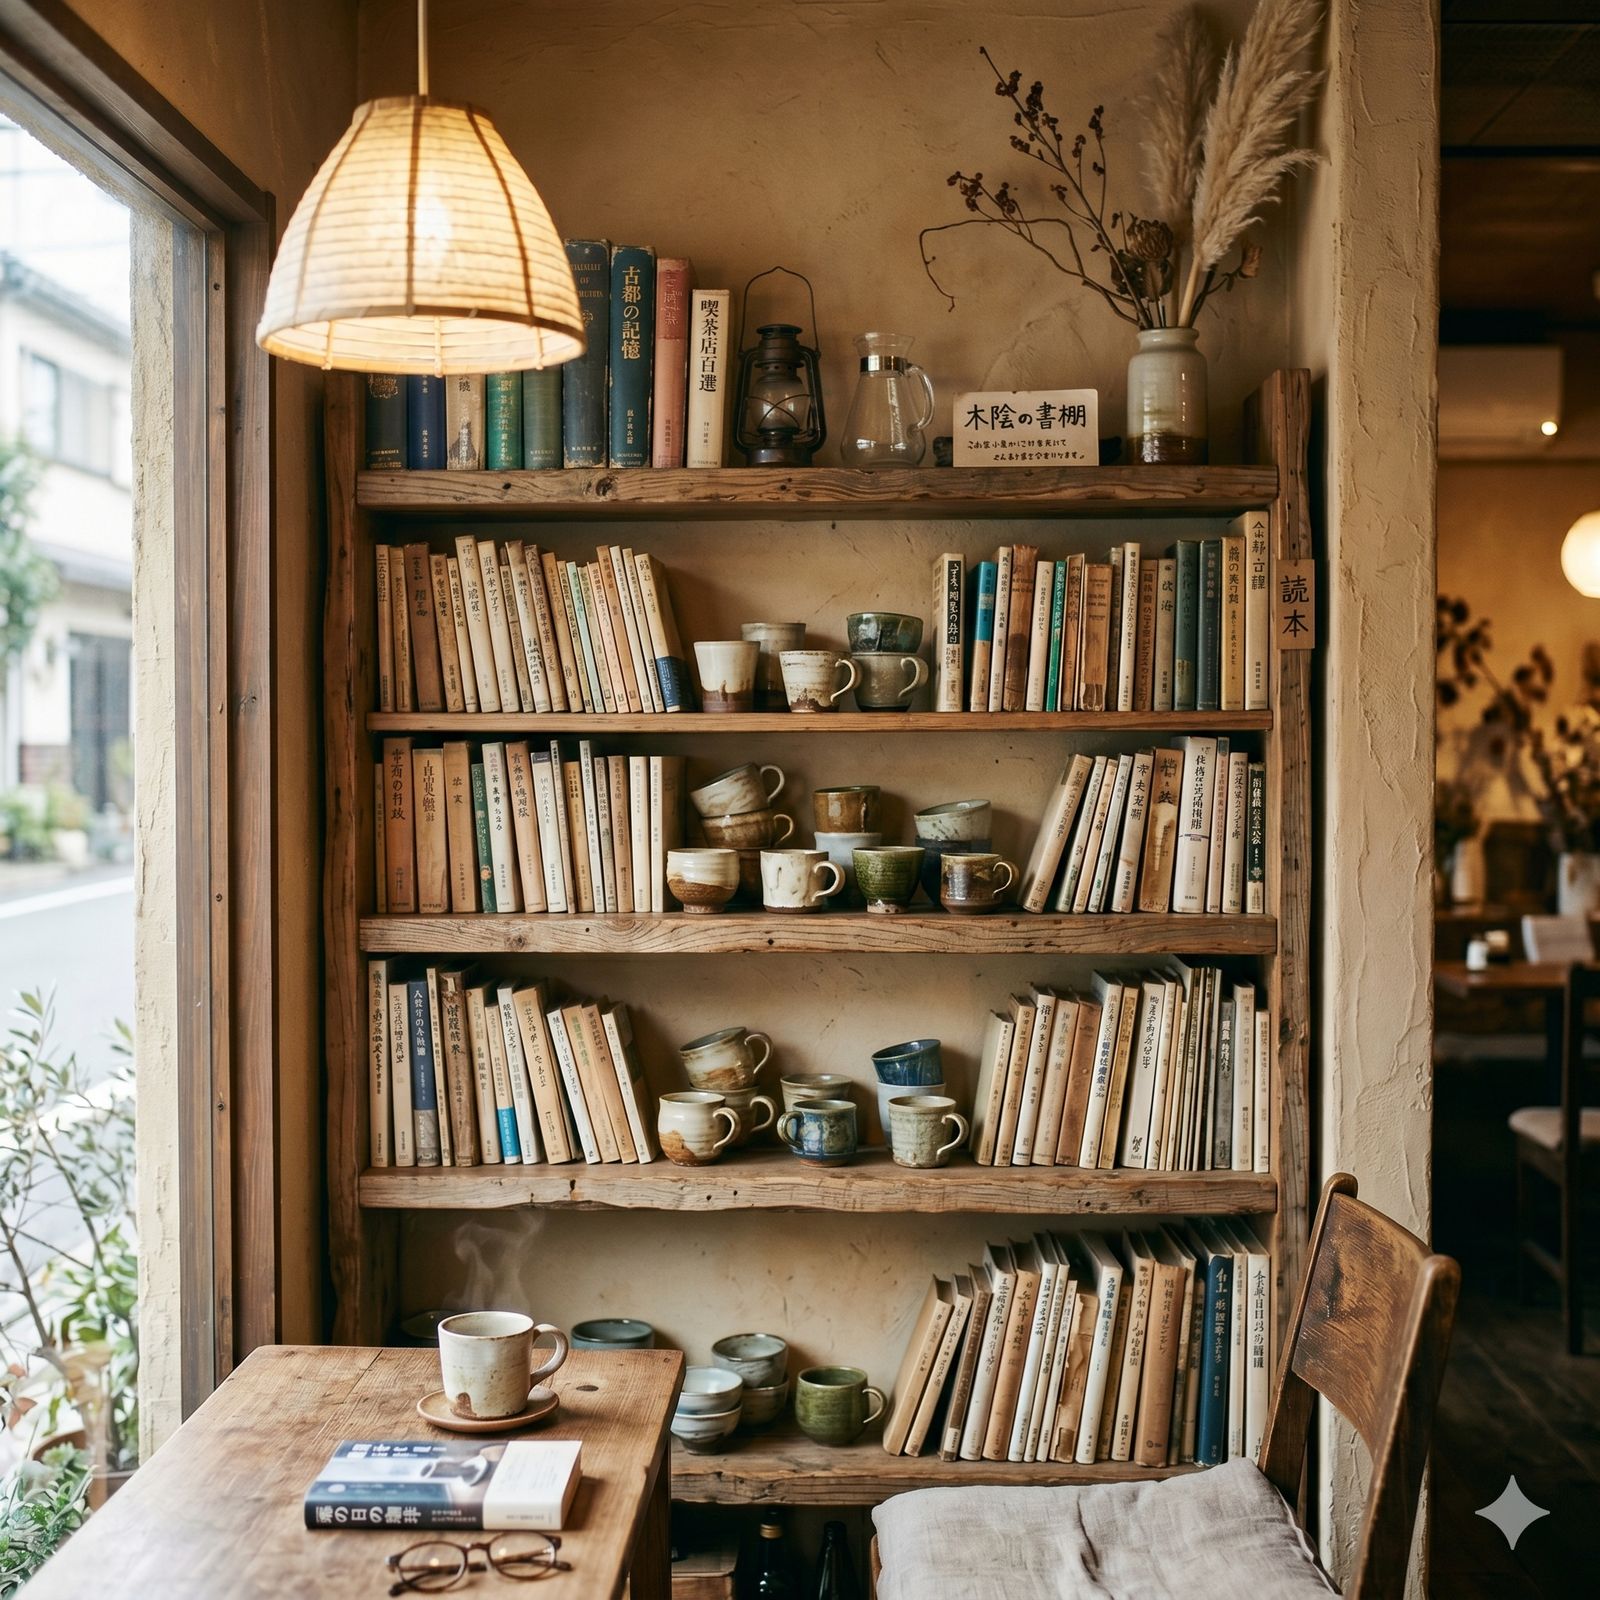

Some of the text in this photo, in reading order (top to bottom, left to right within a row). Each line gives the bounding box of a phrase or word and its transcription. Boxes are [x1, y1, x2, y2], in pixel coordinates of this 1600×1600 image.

[622, 266, 641, 359] 古都の記憶
[699, 299, 718, 392] 喫茶店百選
[964, 401, 1086, 431] 木陰の書棚
[1280, 575, 1309, 638] 読本
